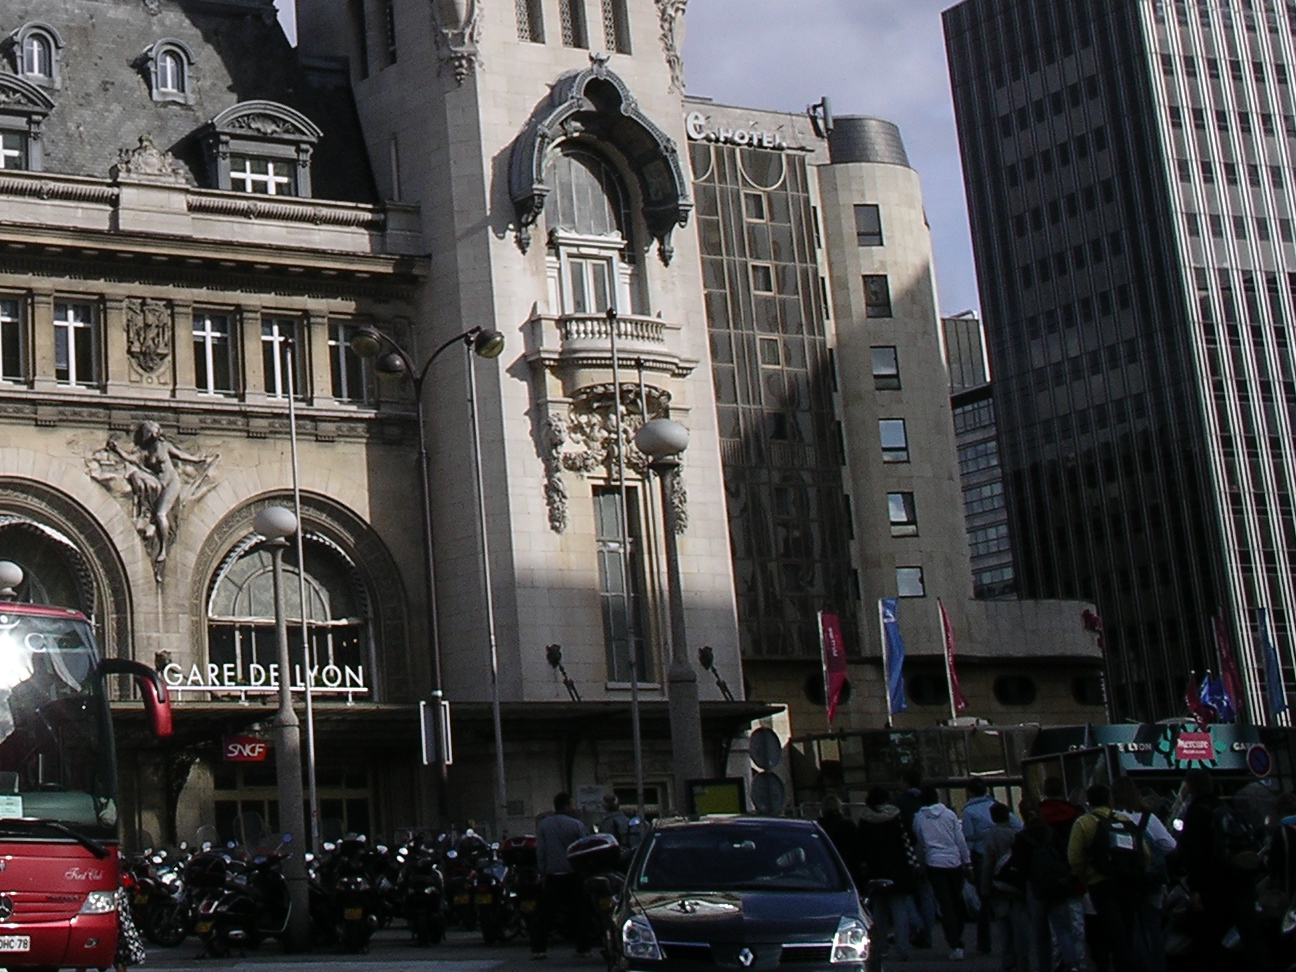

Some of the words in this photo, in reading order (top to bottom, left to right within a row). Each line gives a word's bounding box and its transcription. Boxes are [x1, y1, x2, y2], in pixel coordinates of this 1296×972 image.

[163, 663, 236, 687] GARE
[249, 664, 280, 686] DE
[295, 664, 364, 687] LYON
[227, 743, 265, 757] SNCF
[16, 938, 28, 949] 78
